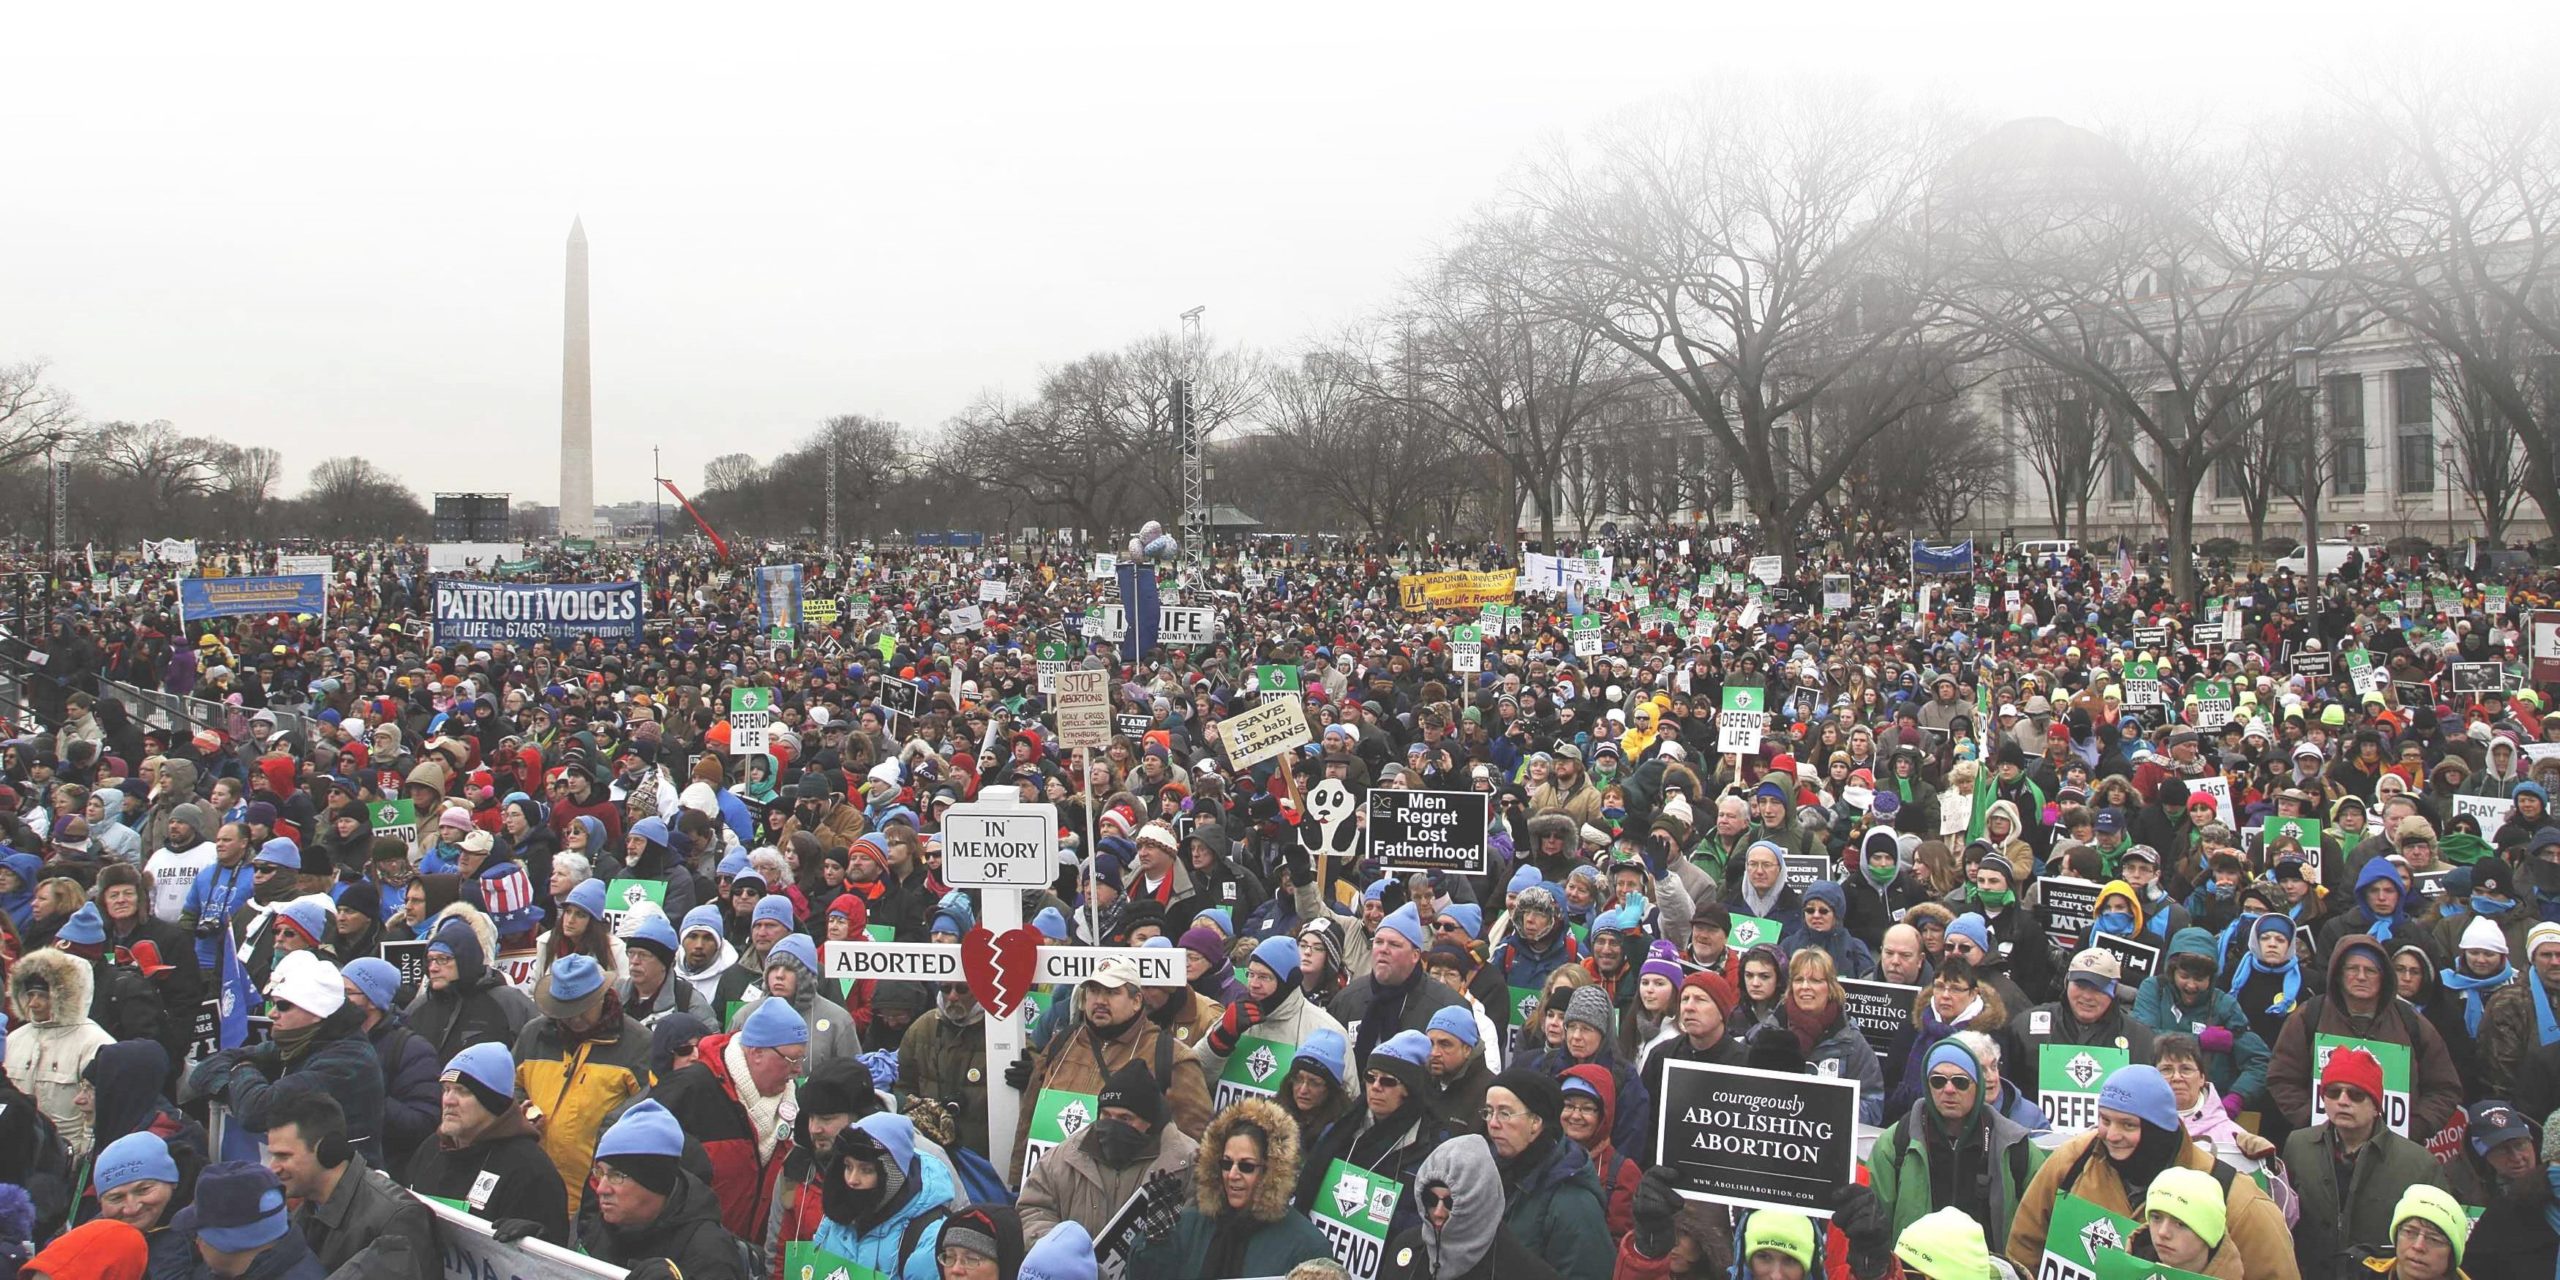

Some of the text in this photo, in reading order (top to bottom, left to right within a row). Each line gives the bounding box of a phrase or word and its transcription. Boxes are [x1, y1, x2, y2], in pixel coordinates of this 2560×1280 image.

[1426, 574, 1467, 584] MADONNA
[437, 589, 636, 621] PATRIOT VOICES
[1455, 594, 1469, 604] Life
[2485, 596, 2504, 604] DEFEND
[2489, 603, 2500, 611] LIFE
[1158, 611, 1202, 632] IFE
[1482, 613, 1502, 625] DEFEND
[440, 623, 461, 637] Text
[463, 622, 488, 638] LIFE
[492, 624, 503, 637] to
[506, 622, 546, 638] 67463
[549, 624, 560, 637] to
[599, 621, 635, 637] more!
[1484, 624, 1496, 632] LIFE
[1574, 630, 1600, 641] DEFEND
[1454, 643, 1480, 655] DEFEND
[1581, 642, 1595, 652] LIFE
[1037, 660, 1067, 673] DEFEND
[1460, 656, 1473, 667] LIFE
[2351, 666, 2372, 679] DEFEND
[1062, 672, 1102, 692] STOP
[2127, 680, 2158, 692] DEFEND
[2360, 676, 2371, 688] LIFE
[1060, 694, 1103, 704] ABORTIONS
[2134, 692, 2152, 704] LIFE
[2198, 699, 2230, 712] DEFEND
[733, 713, 768, 729] DEFEND
[1062, 711, 1105, 720] HOLY CROSS
[1128, 718, 1147, 727] AM
[1236, 704, 1286, 731] SAVE
[1722, 712, 1762, 729] DEFEND
[2207, 713, 2225, 726] LIFE
[1235, 715, 1292, 745] the baby
[1728, 730, 1750, 746] LIFE
[740, 731, 760, 747] LIFE
[1231, 723, 1306, 761] HUMANS
[2200, 783, 2225, 797] FAST
[1408, 794, 1446, 810] Men
[1397, 807, 1458, 828] Regret
[984, 821, 1006, 838] IN
[1407, 826, 1447, 844] Lost
[952, 841, 1040, 860] MEMORY
[1374, 841, 1479, 863] Fatherhood
[157, 867, 200, 878] REAL MEN
[984, 861, 1009, 879] OF
[837, 951, 956, 975] ABORTED
[1844, 992, 1892, 1006] ourageously
[1843, 1001, 1907, 1020] OLISHING
[1712, 1089, 1805, 1117] courageously
[2041, 1094, 2096, 1128] DEFE
[1682, 1106, 1834, 1140] ABOLISHING
[1691, 1132, 1821, 1164] ABORTION
